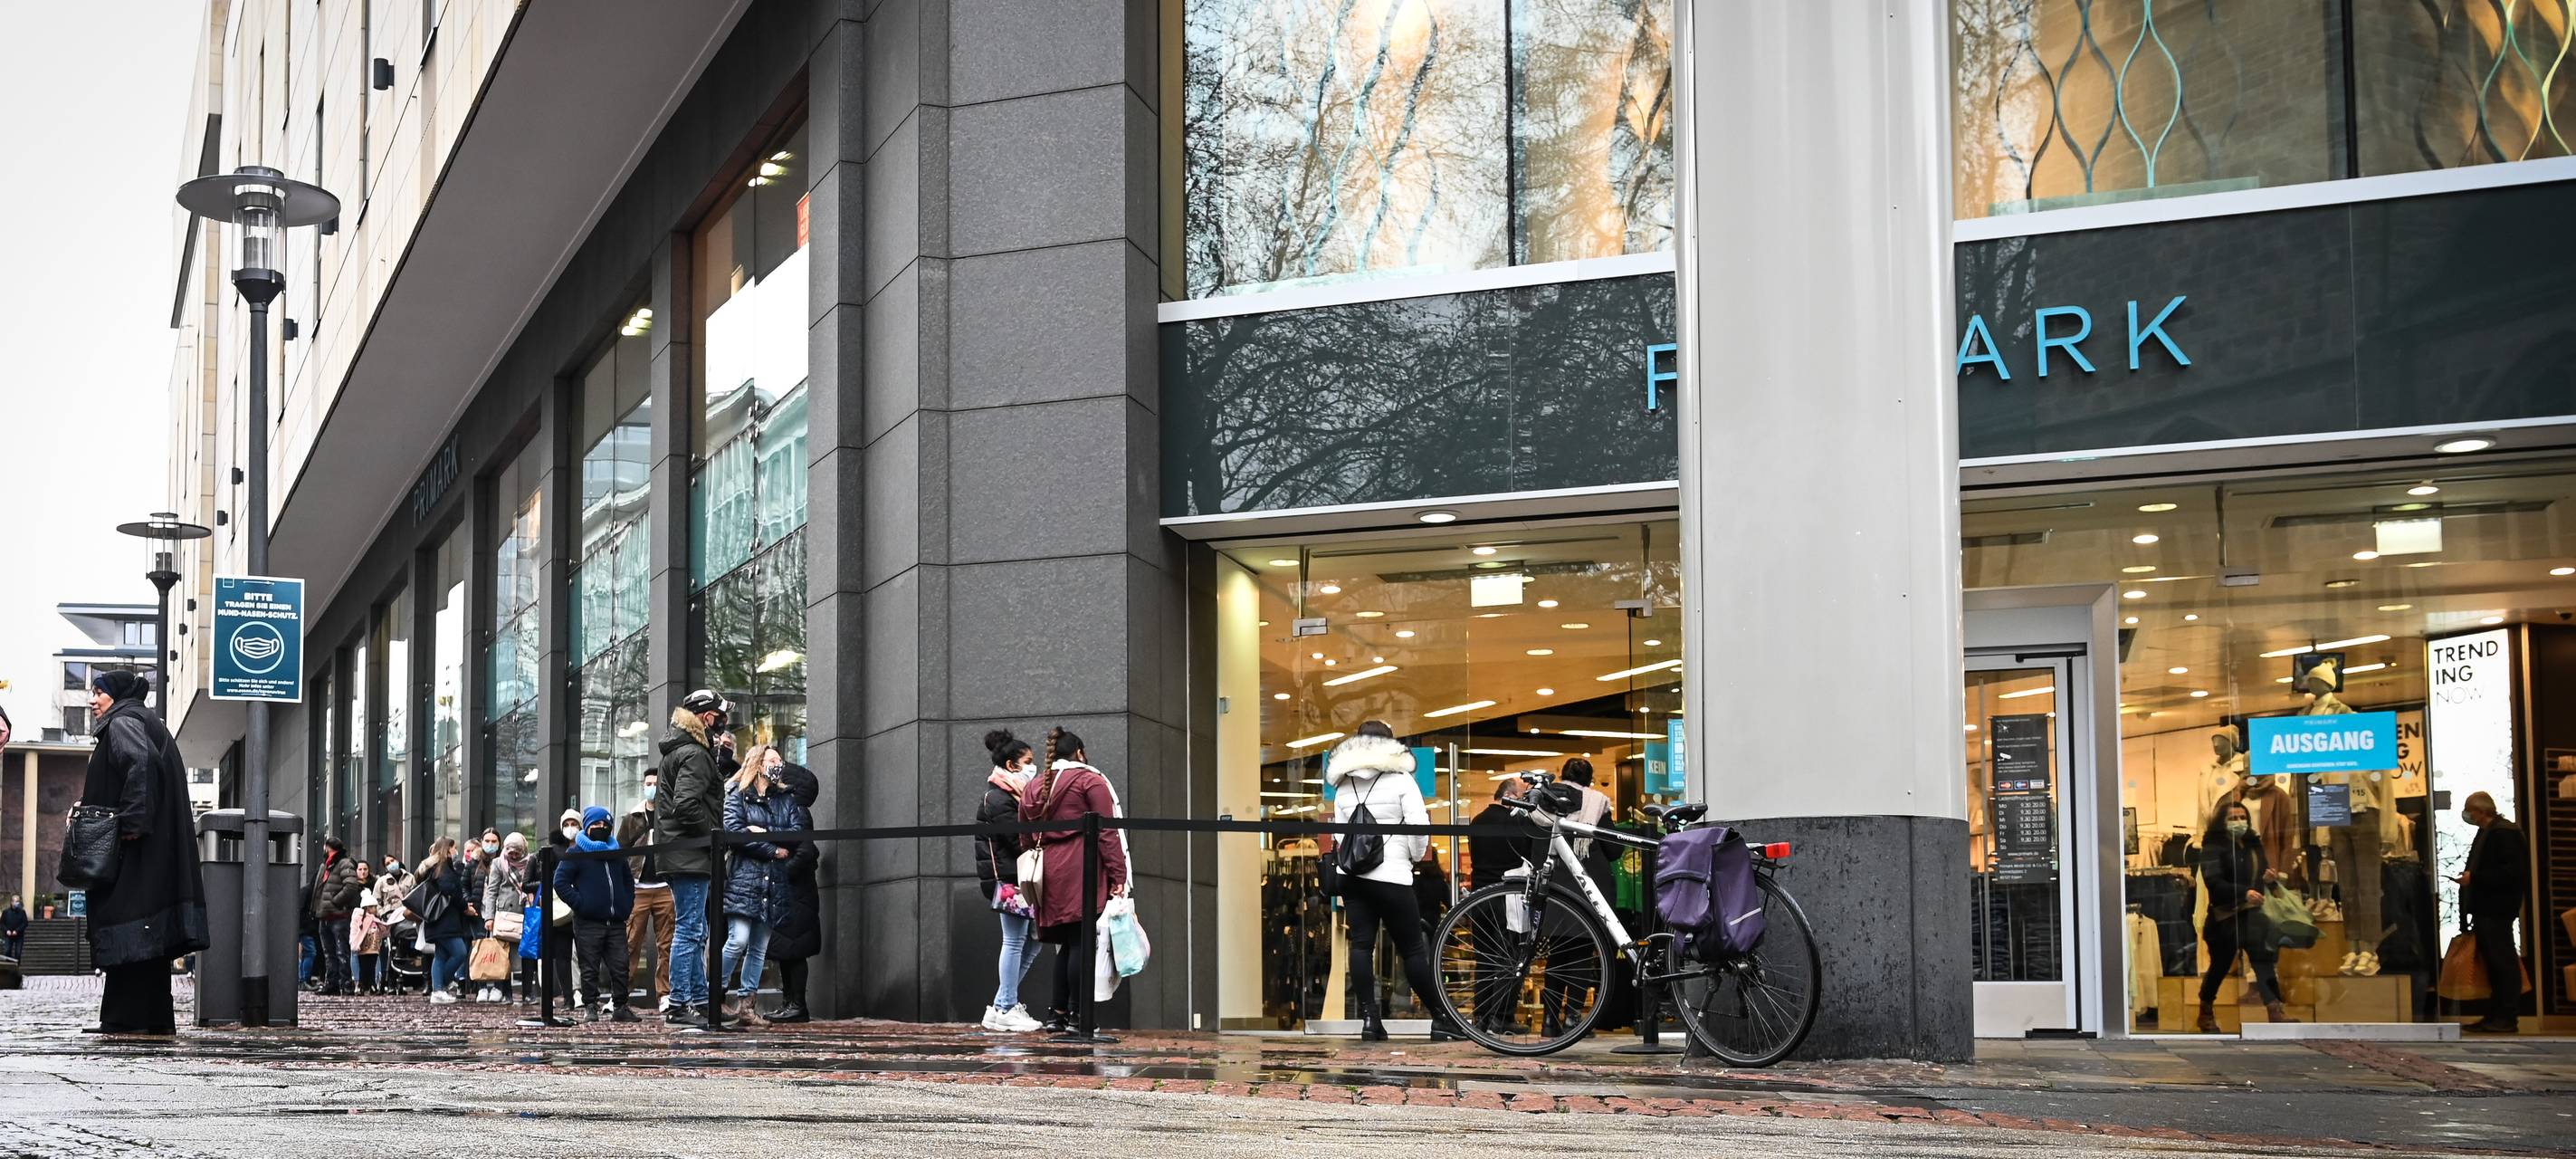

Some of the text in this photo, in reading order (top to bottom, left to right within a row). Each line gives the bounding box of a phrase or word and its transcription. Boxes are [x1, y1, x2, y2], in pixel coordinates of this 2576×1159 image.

[414, 435, 458, 529] PRIMARK
[243, 592, 273, 601] BITTE
[217, 609, 298, 619] MUND-NASEN-SCHUTZ.
[2434, 640, 2498, 664] TREND
[2436, 666, 2473, 685] ING
[2437, 687, 2485, 706] NOW
[2270, 730, 2375, 754] AUSGANG
[1648, 760, 1666, 775] KEIN
